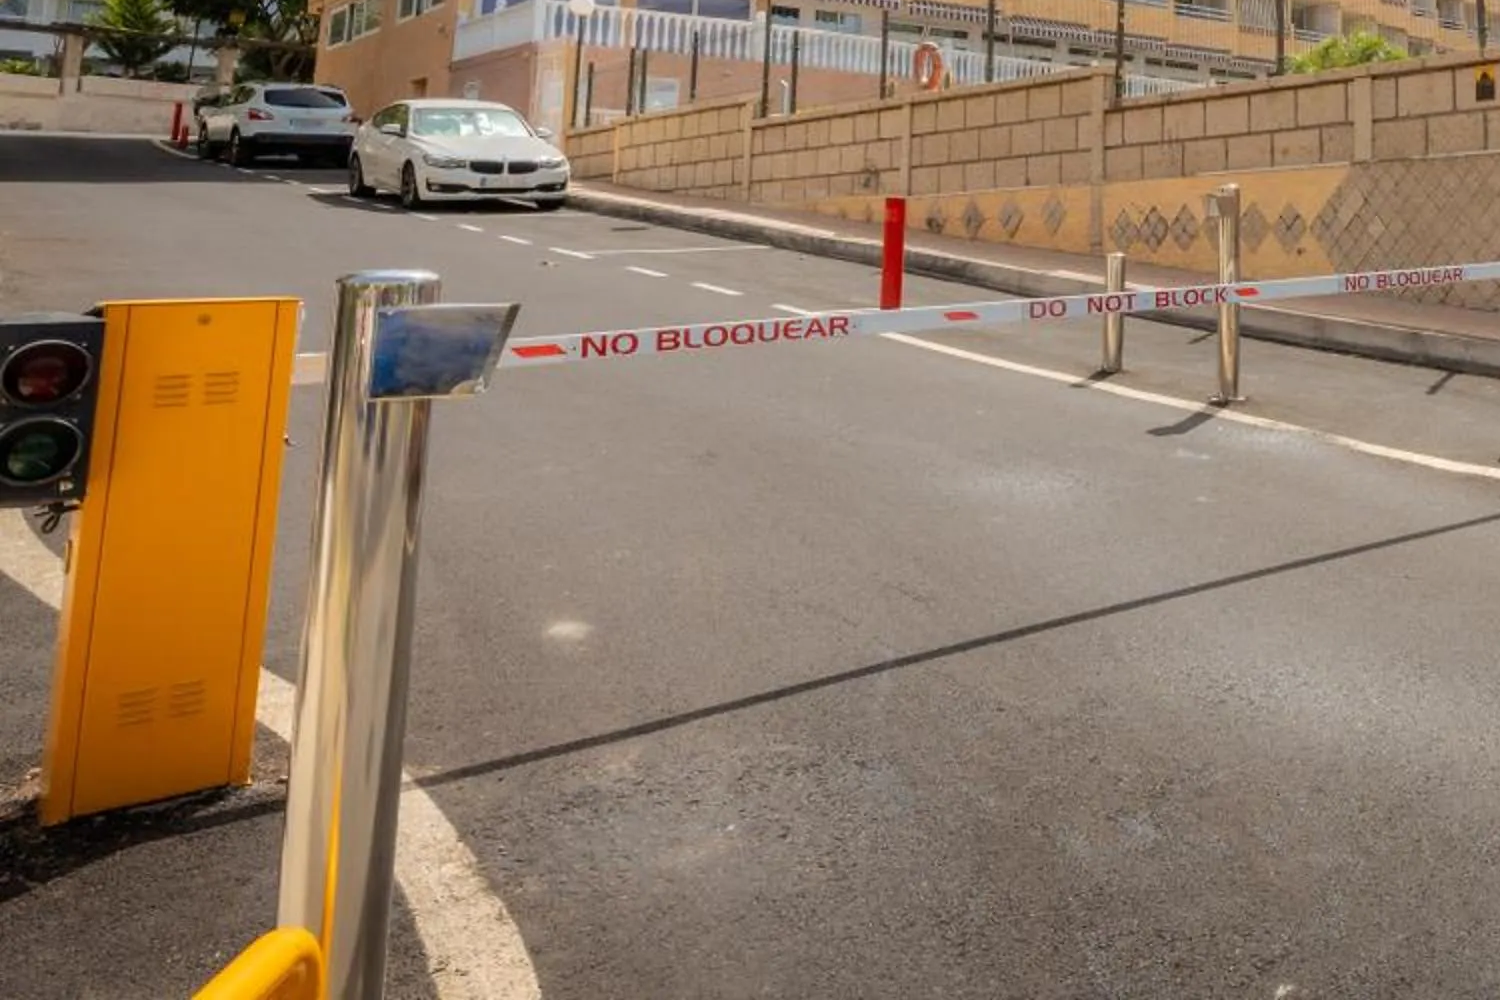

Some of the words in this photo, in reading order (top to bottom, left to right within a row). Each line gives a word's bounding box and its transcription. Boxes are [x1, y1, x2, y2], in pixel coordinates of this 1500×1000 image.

[1344, 274, 1370, 292] NO
[1376, 268, 1464, 289] BLOQUEAR
[1029, 299, 1067, 320] DO
[1086, 293, 1137, 315] NOT
[1155, 287, 1228, 309] BLOCK
[580, 333, 639, 359] NO
[656, 316, 850, 352] BLOQUEAR
